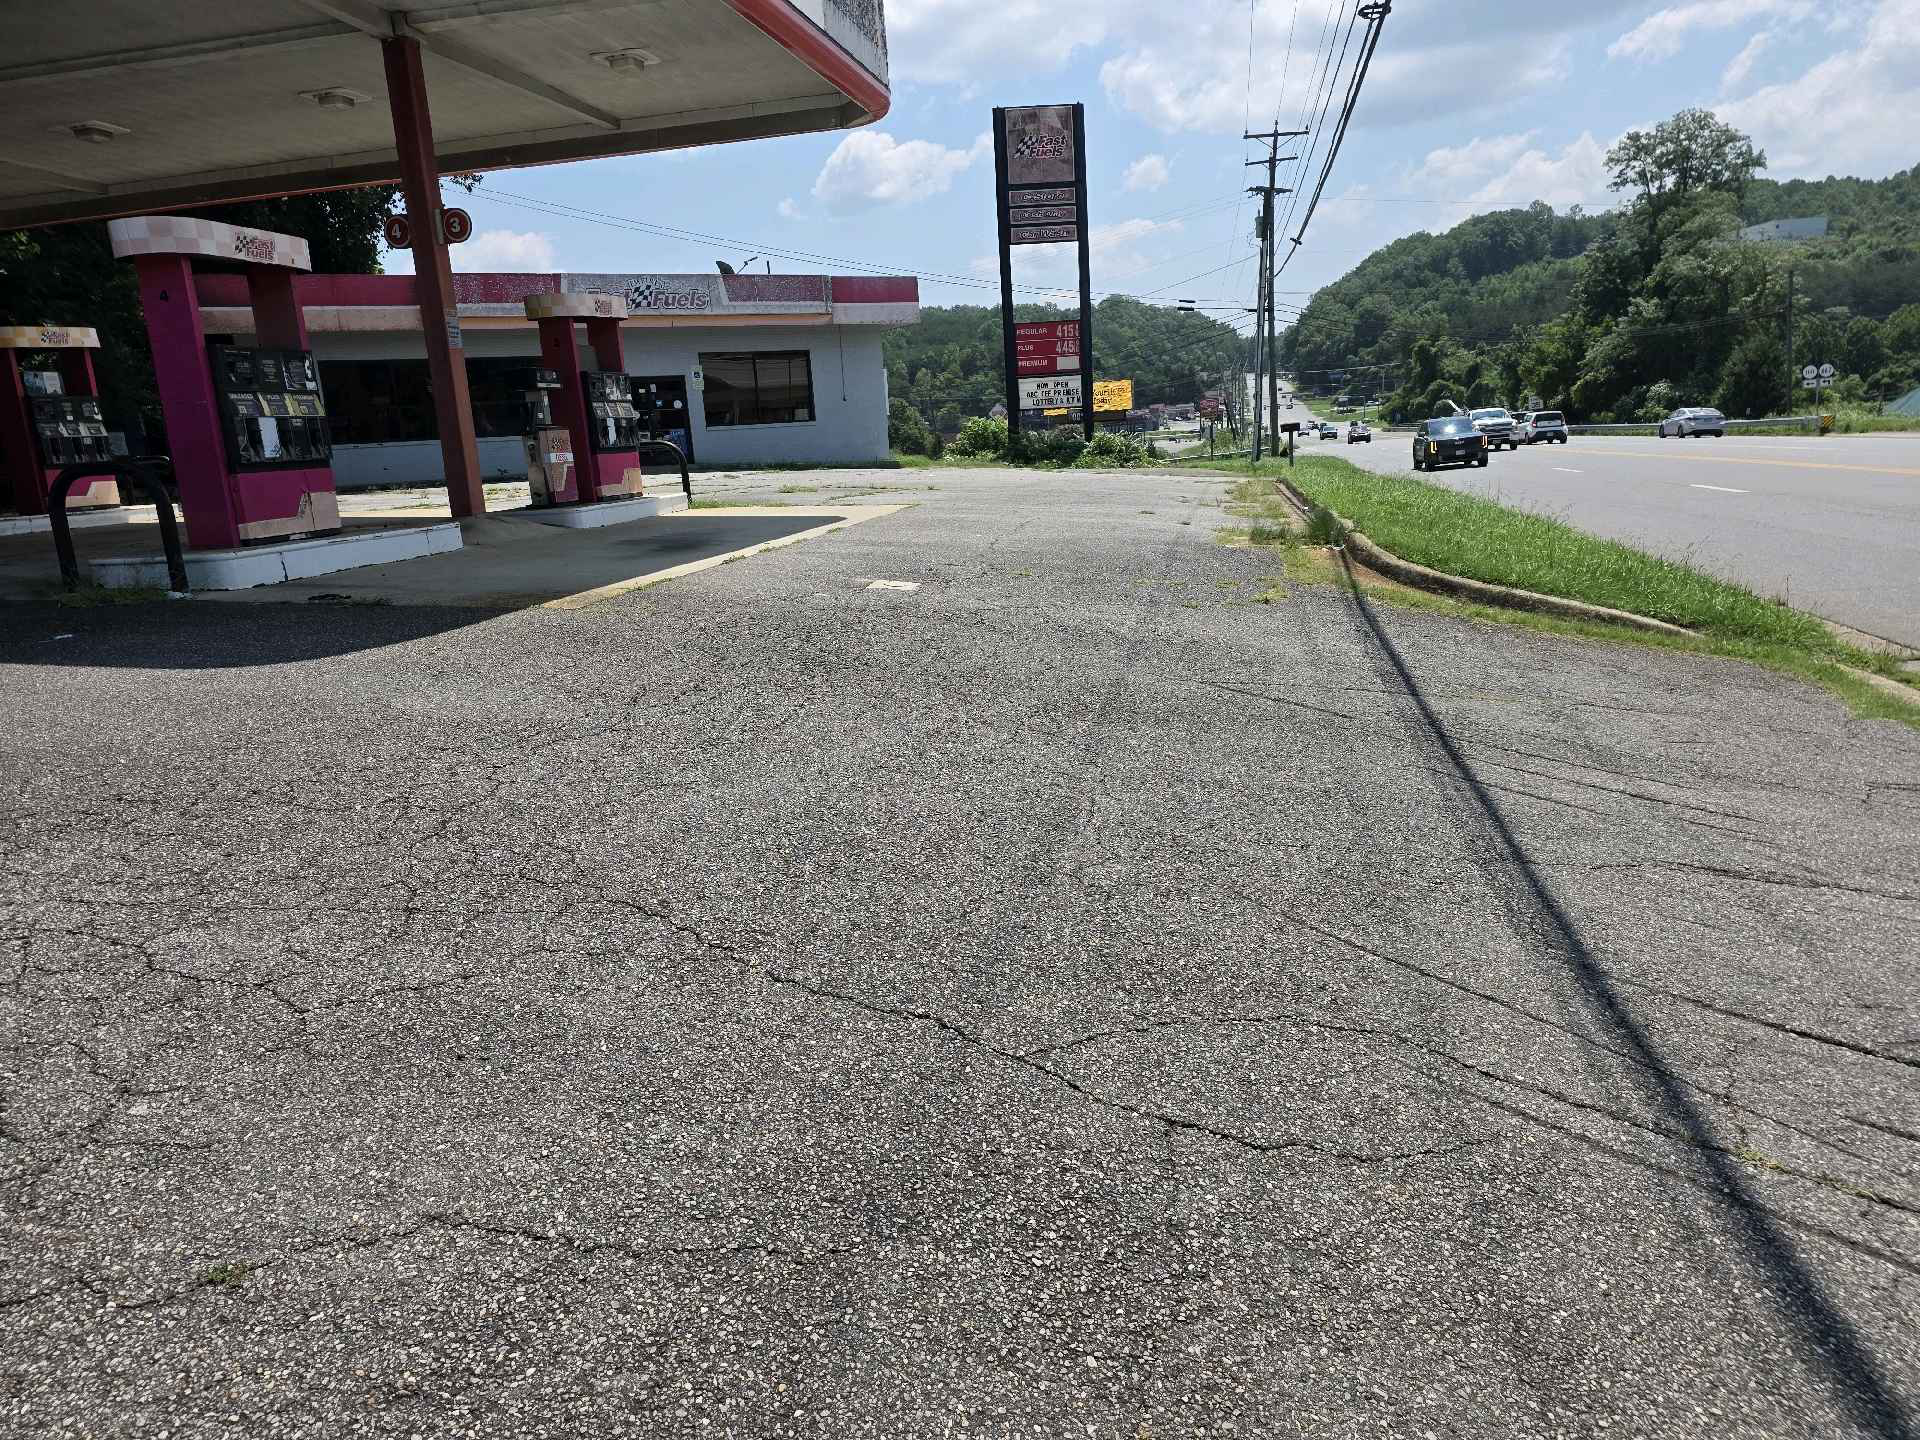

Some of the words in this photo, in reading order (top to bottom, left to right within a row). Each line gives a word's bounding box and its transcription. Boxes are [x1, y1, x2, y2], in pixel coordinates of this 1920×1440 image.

[1038, 134, 1067, 147] Fast
[1029, 145, 1063, 159] Fuels
[391, 223, 402, 239] 4
[449, 217, 461, 233] 3
[246, 246, 274, 260] Fuels
[651, 288, 709, 310] Fuels
[1016, 327, 1048, 336] REGULAR
[1017, 344, 1034, 352] PLUS
[1018, 359, 1048, 368] PREMIUM
[1053, 381, 1069, 390] OPEN
[1032, 397, 1058, 407] LOTTERY
